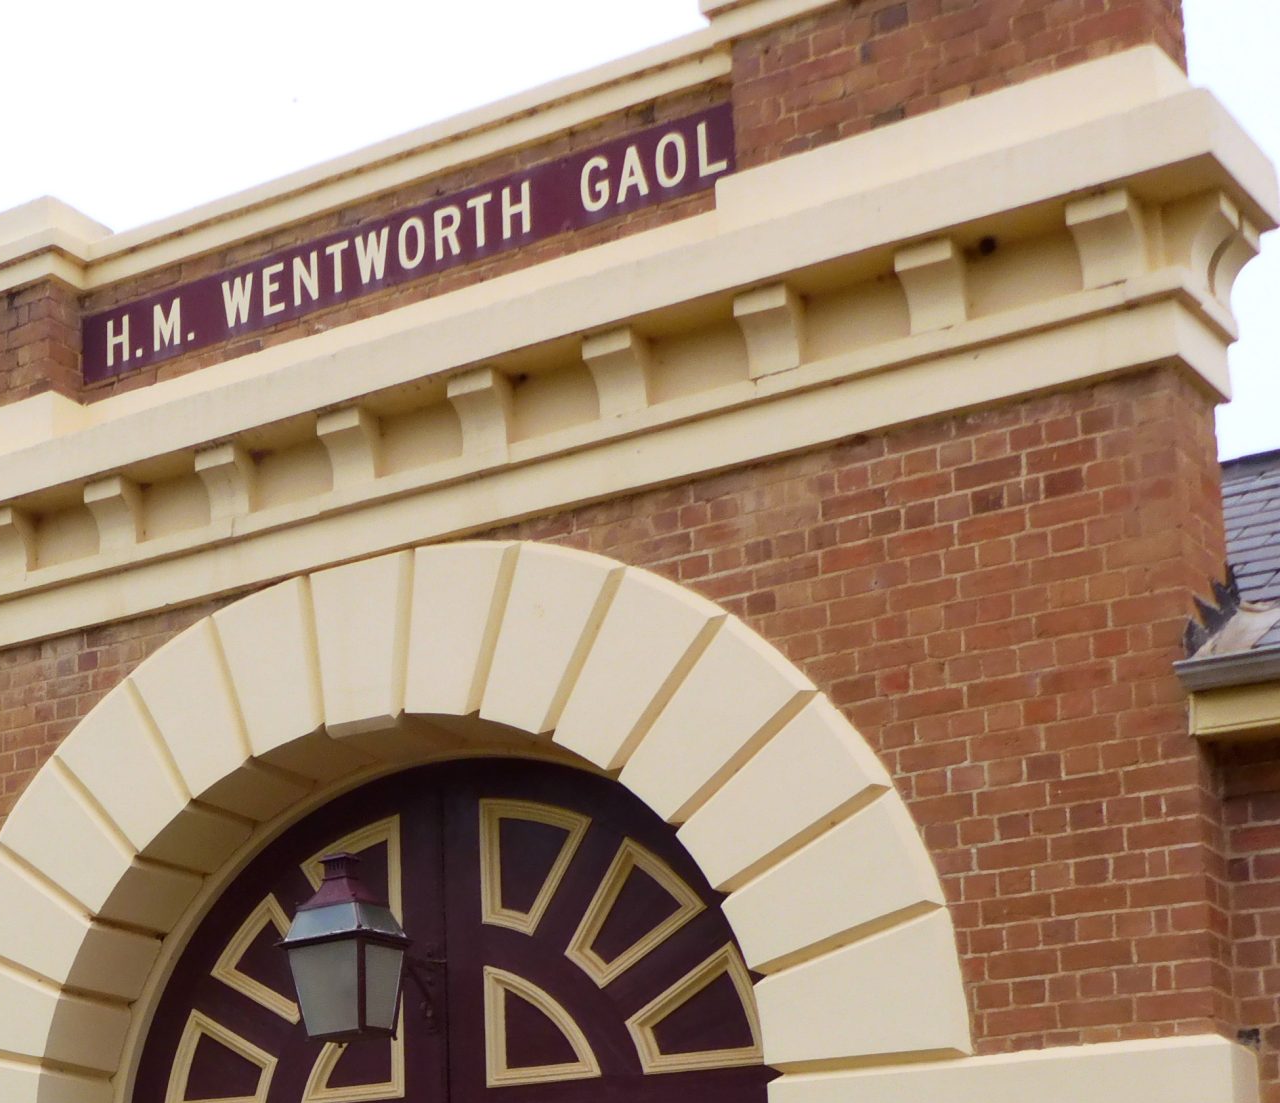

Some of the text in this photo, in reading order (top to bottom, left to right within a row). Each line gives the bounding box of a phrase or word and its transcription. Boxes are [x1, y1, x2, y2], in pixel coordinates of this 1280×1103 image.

[106, 121, 728, 367] H.M. WENTWORTH GAOL
